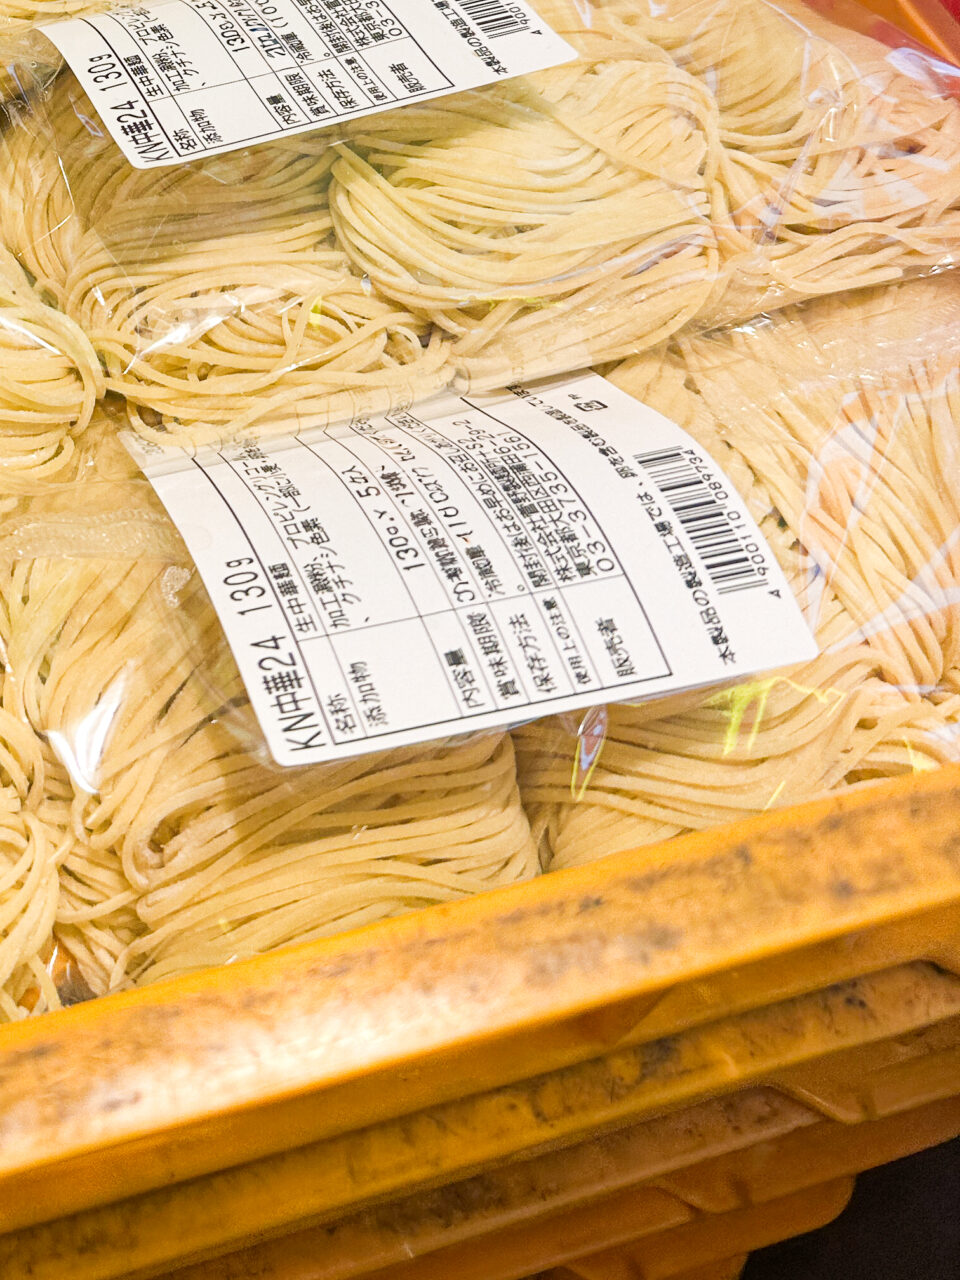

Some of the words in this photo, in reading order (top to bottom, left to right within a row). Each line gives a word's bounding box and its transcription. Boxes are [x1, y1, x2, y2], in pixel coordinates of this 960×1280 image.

[86, 53, 129, 92] 130g
[284, 71, 332, 117] 賞味期限
[317, 68, 360, 110] 保存方法
[344, 56, 388, 102] 使用上の注意
[387, 62, 428, 94] 販売者
[109, 99, 174, 163] KN中華24
[189, 108, 224, 145] 添加物
[265, 92, 302, 126] 内容量
[172, 128, 199, 152] 名称
[495, 430, 616, 572] 03-3735-1561
[684, 449, 729, 501] 089734
[726, 510, 770, 577] 900110
[222, 557, 273, 616] 130g
[767, 589, 782, 599] 4
[466, 612, 521, 700] 賞味期限
[509, 613, 558, 693] 保存方法
[542, 596, 592, 685] 使用上の注意
[595, 617, 637, 678] 販売者
[249, 634, 327, 752] KN中華24
[348, 661, 389, 727] 添加物
[443, 647, 485, 709] 内容量
[326, 692, 357, 735] 名称
